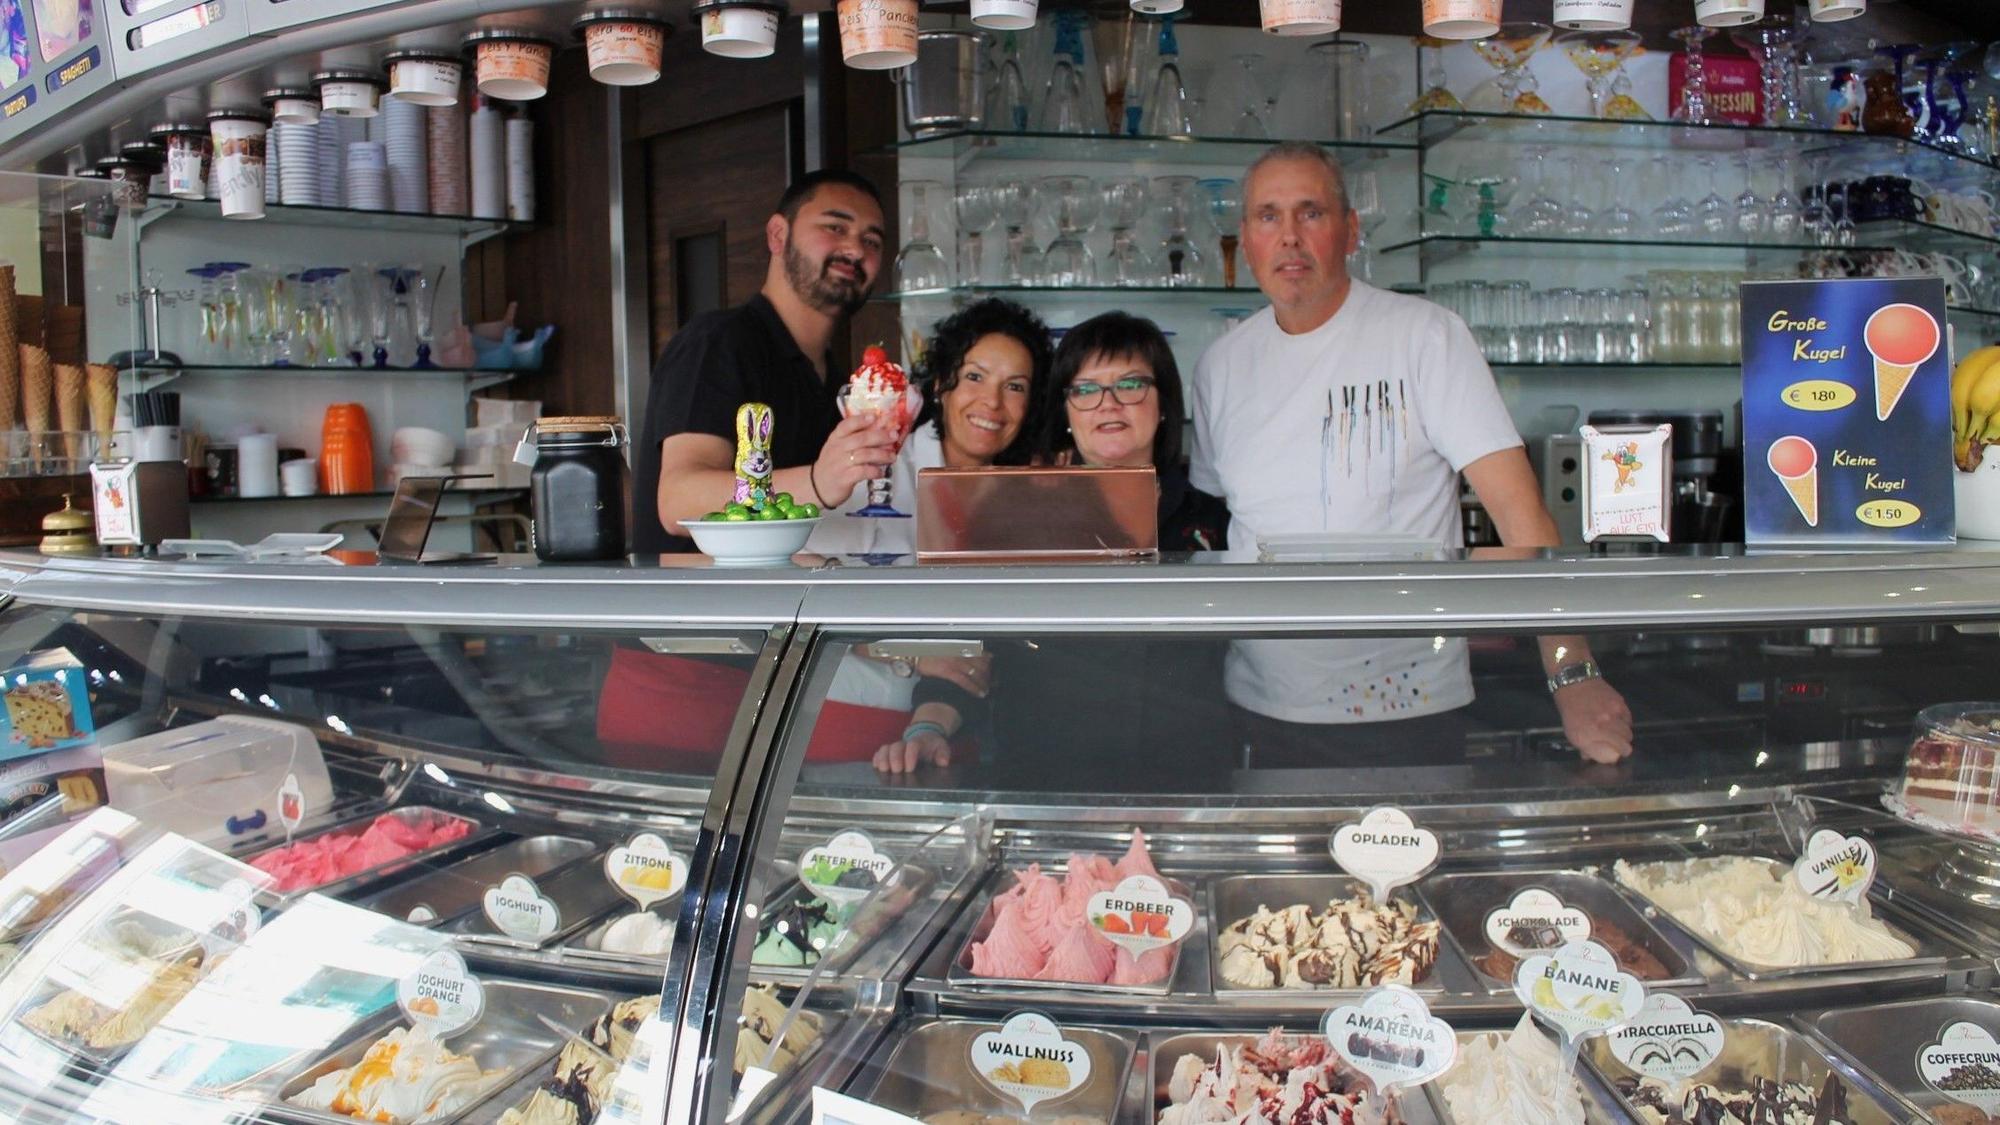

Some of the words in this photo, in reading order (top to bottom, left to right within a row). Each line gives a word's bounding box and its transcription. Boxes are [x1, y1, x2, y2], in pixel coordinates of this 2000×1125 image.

[60, 56, 91, 85] SPAGHETTI
[1767, 310, 1827, 332] Große
[1793, 339, 1846, 363] Kugel
[1832, 449, 1877, 467] Kleine
[1865, 472, 1906, 492] Kugel
[1875, 508, 1902, 520] 1.50
[1351, 832, 1420, 847] OPLADEN
[624, 854, 672, 871] ZITRONE
[811, 854, 847, 866] AFTER
[851, 858, 887, 871] EIGHT
[1811, 845, 1857, 875] VANILLE
[495, 895, 543, 915] JOGHURT
[1105, 899, 1175, 915] ERDBEER
[1497, 917, 1580, 928] SCHOKOLADE
[417, 973, 464, 992] JOGHURT
[1544, 966, 1620, 993] BANANE
[417, 986, 462, 1005] ORANGE
[1346, 1013, 1435, 1043] AMARENA
[987, 1041, 1074, 1063] WALLNUSS
